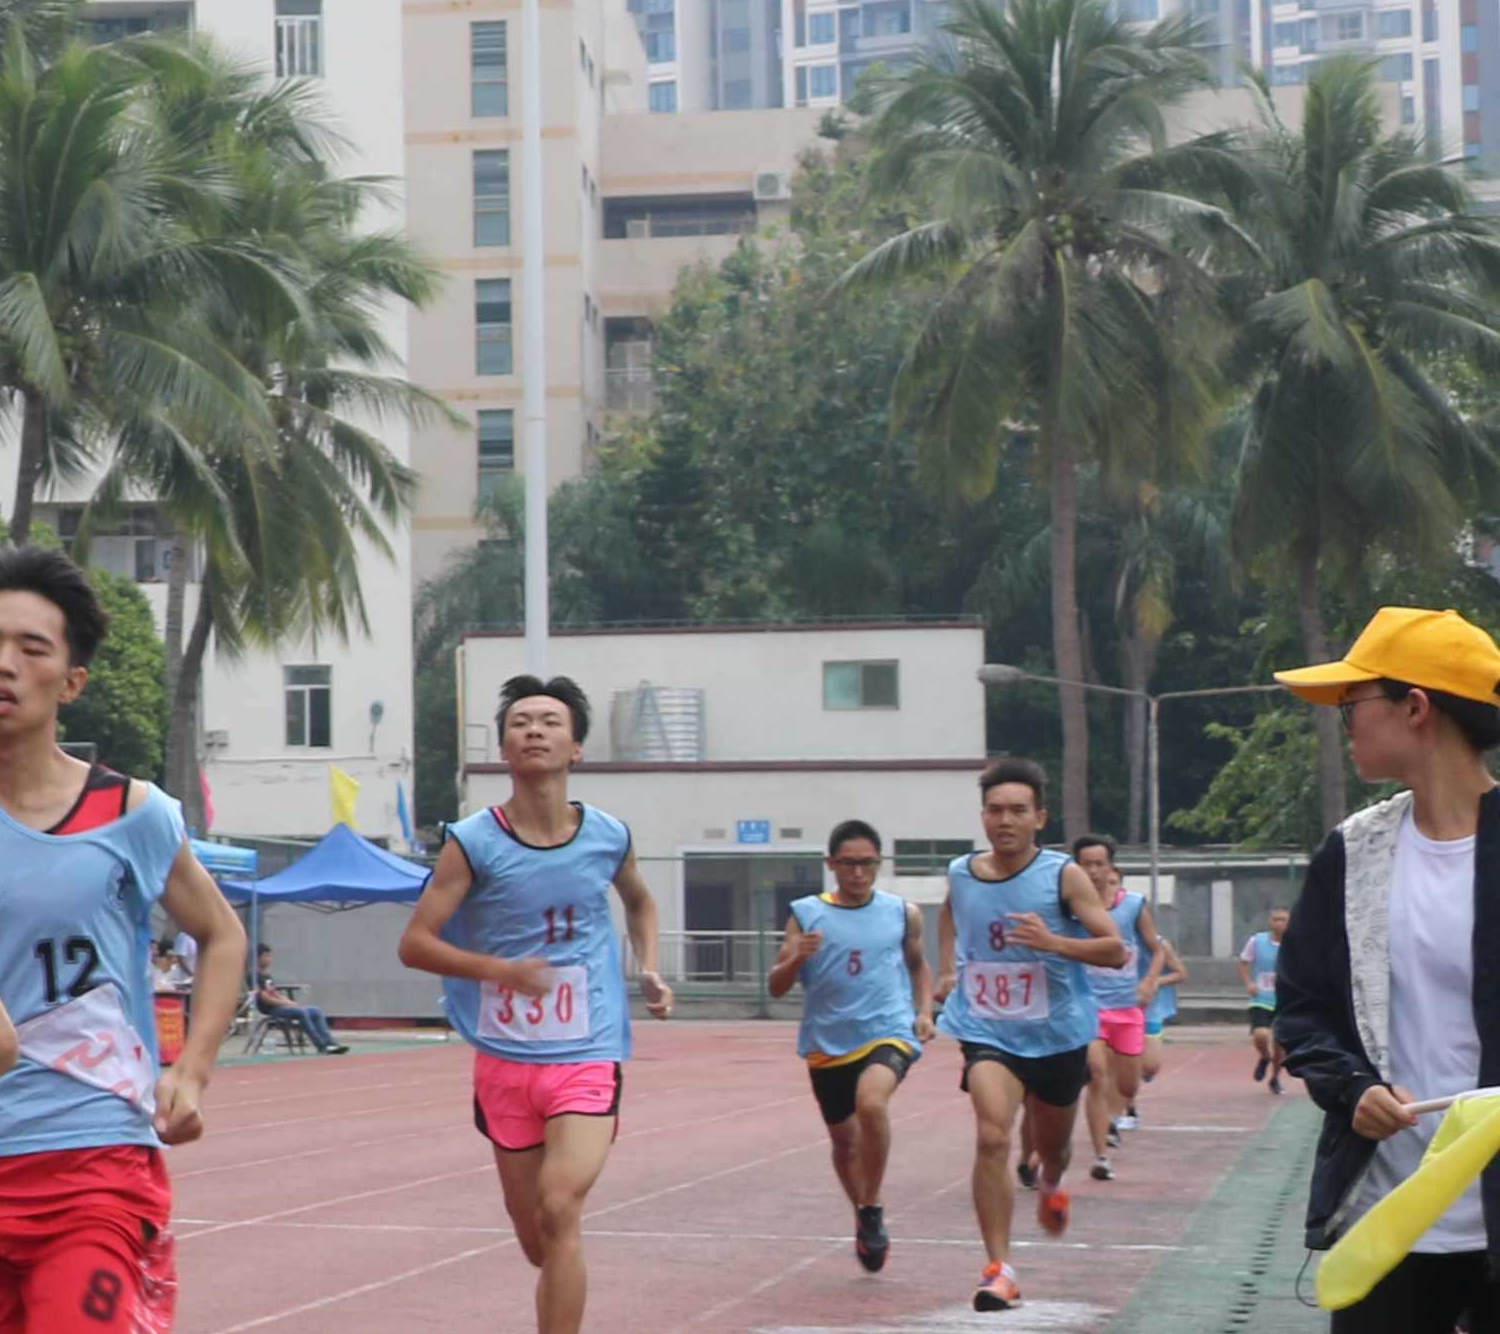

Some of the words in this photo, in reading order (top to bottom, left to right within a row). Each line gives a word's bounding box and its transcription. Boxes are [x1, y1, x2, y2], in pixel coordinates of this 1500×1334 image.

[988, 920, 1007, 953] 8
[34, 935, 100, 1006] 12
[847, 949, 863, 977] 5
[497, 982, 574, 1026] 330
[975, 972, 1034, 1007] 287
[82, 1269, 122, 1323] 8
